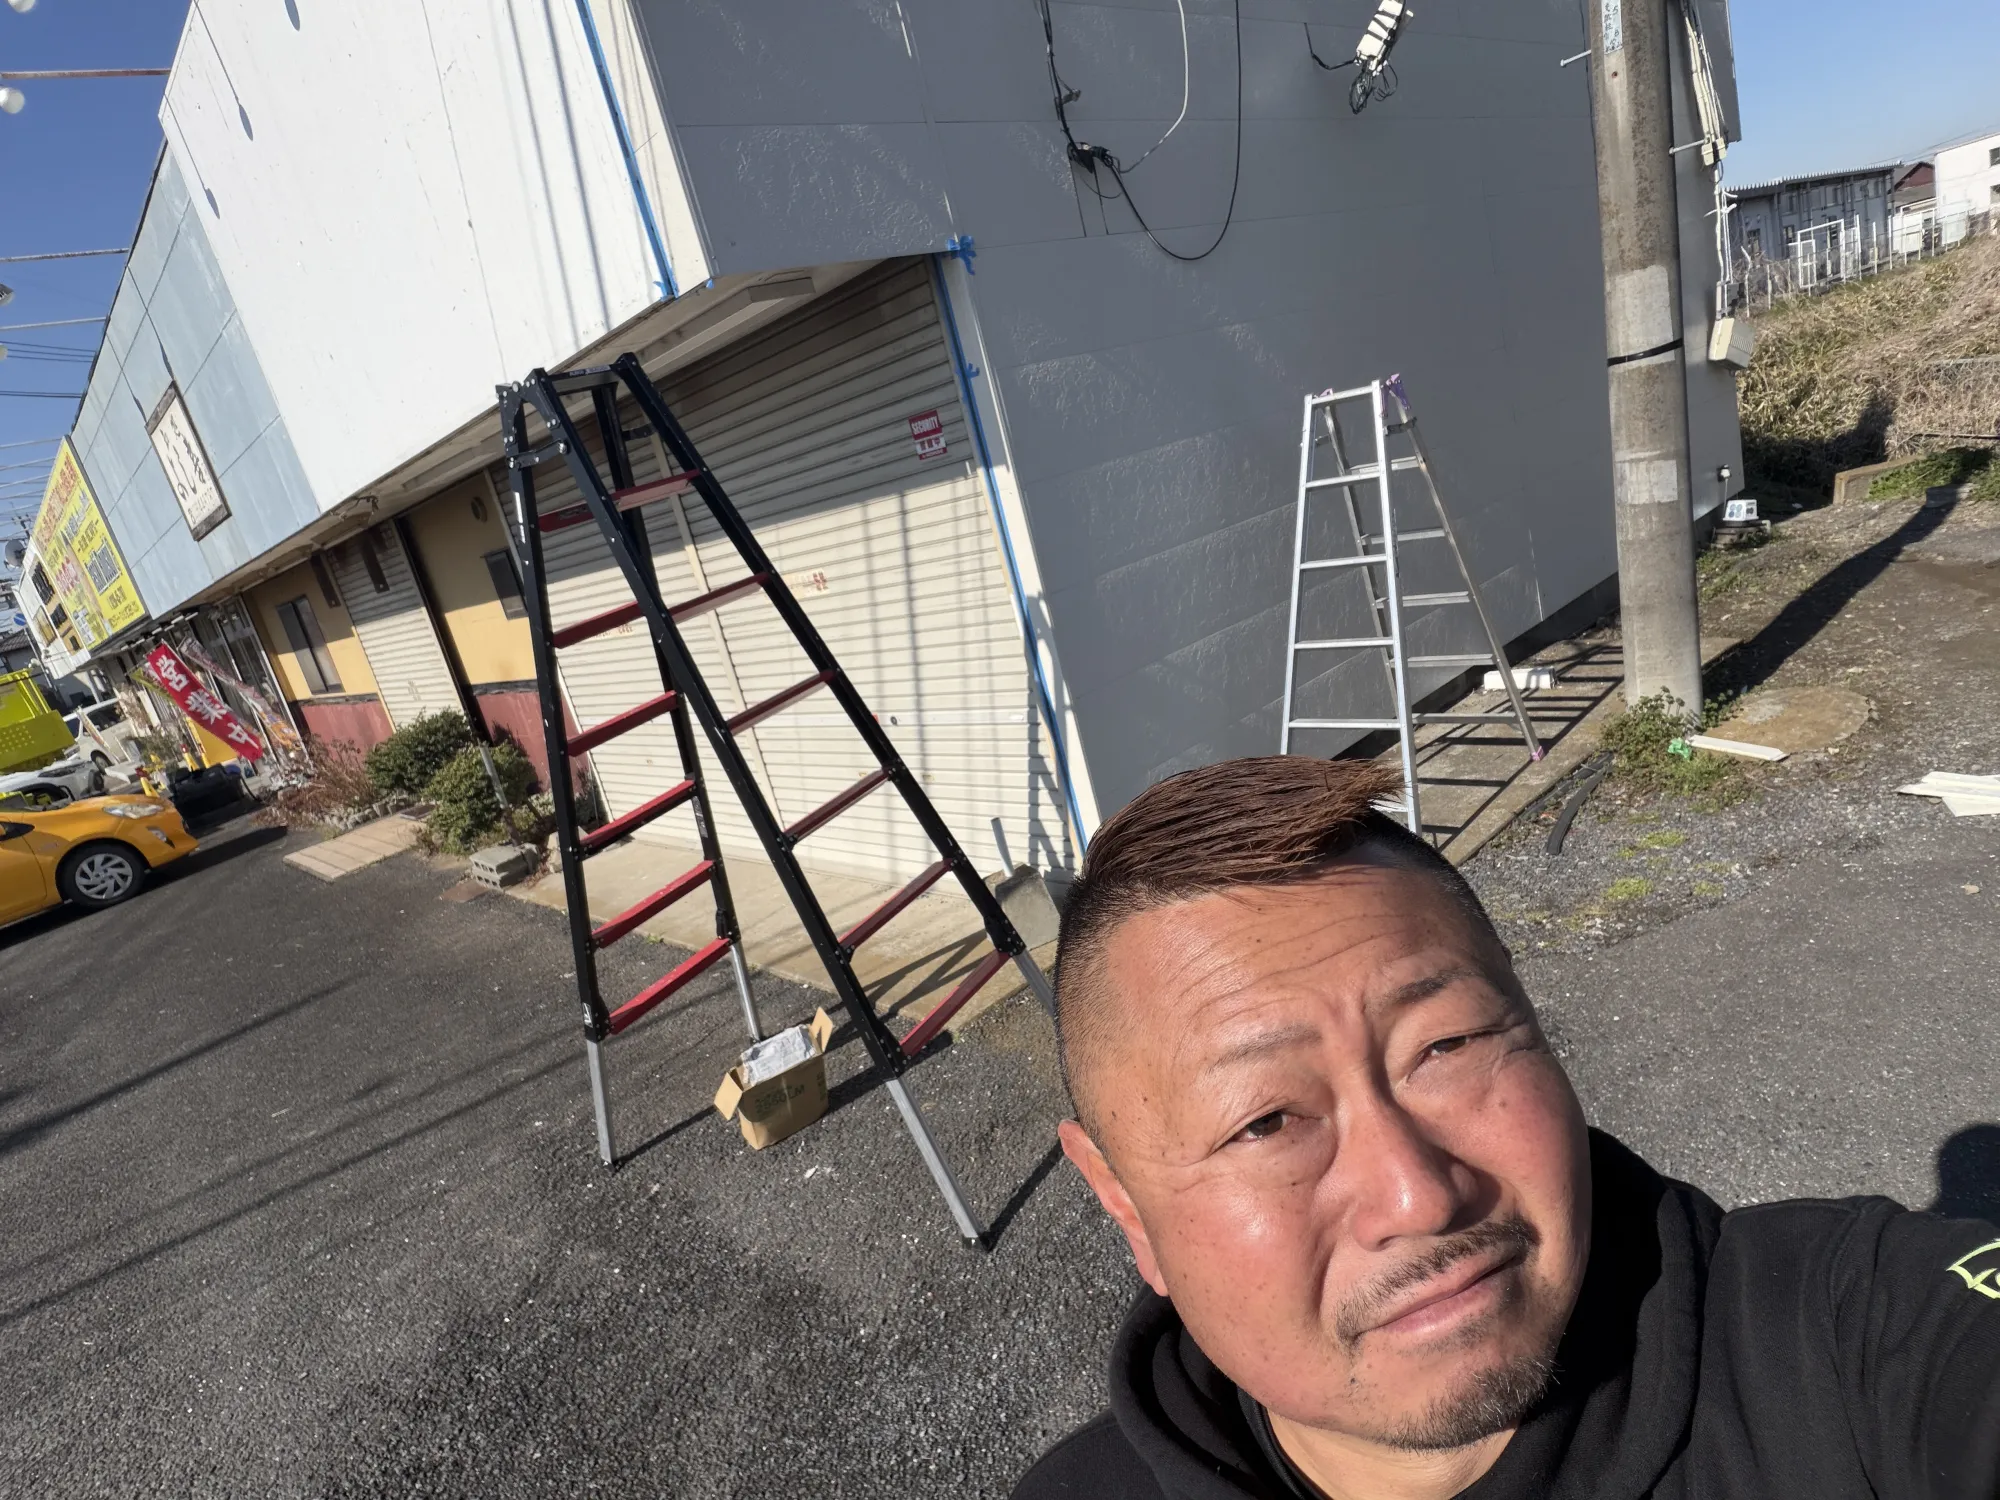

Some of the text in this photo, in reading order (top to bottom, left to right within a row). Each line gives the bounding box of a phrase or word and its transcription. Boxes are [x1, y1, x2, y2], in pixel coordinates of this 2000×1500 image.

[911, 416, 938, 435] SECURITY
[156, 654, 259, 750] 営業中
